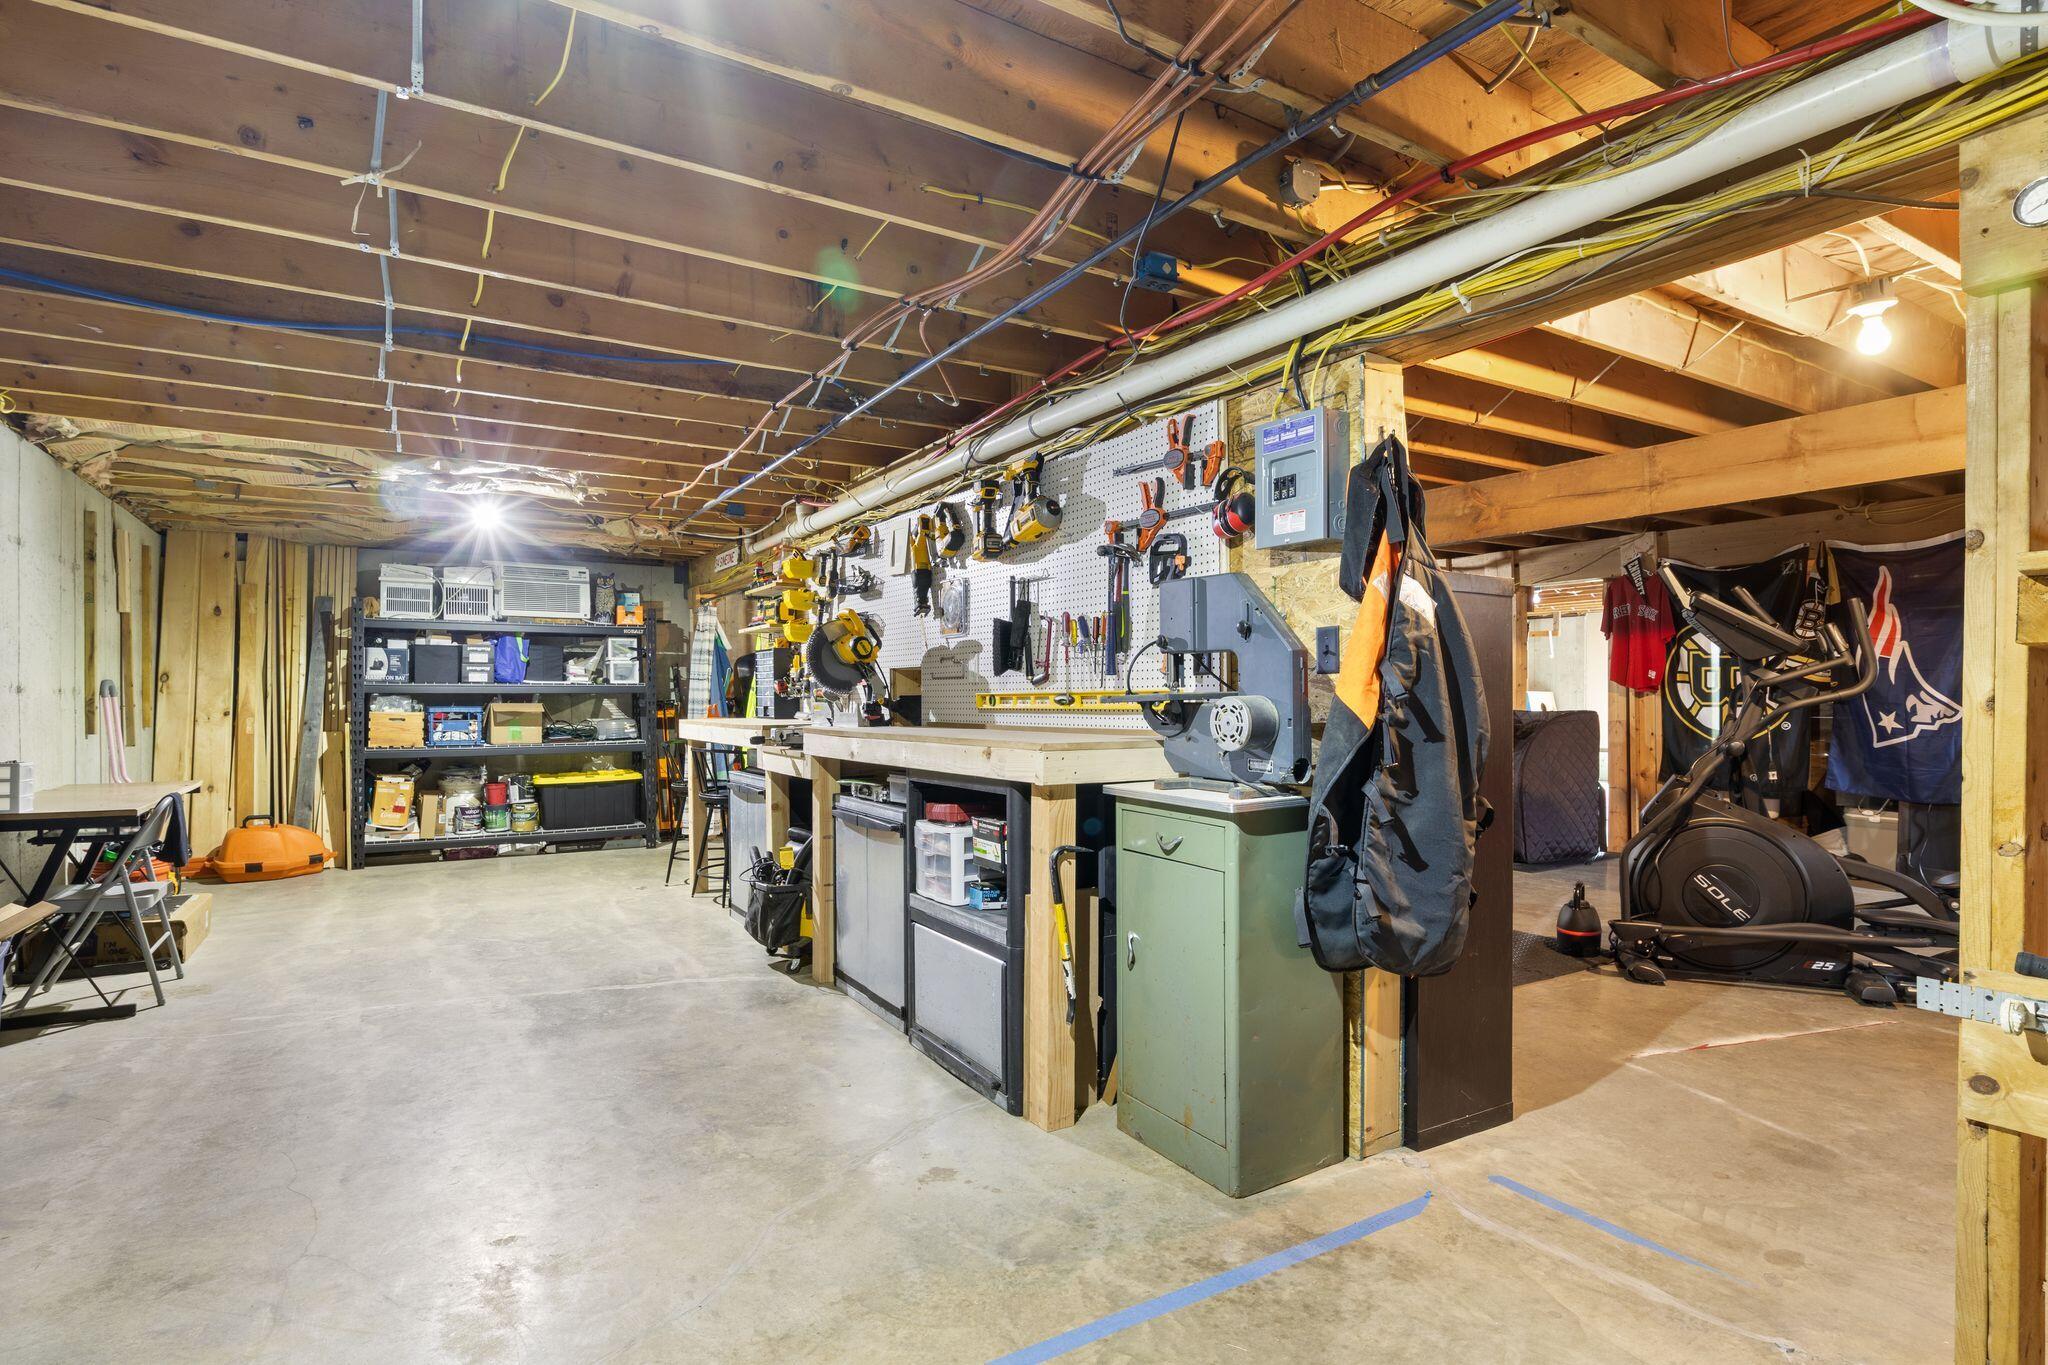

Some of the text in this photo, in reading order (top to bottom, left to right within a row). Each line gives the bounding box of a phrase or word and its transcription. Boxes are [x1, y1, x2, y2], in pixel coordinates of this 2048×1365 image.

[1627, 560, 1645, 595] ENDICOTT
[1637, 604, 1659, 622] SOX
[1693, 874, 1751, 922] SOLE
[1803, 960, 1836, 971] E25
